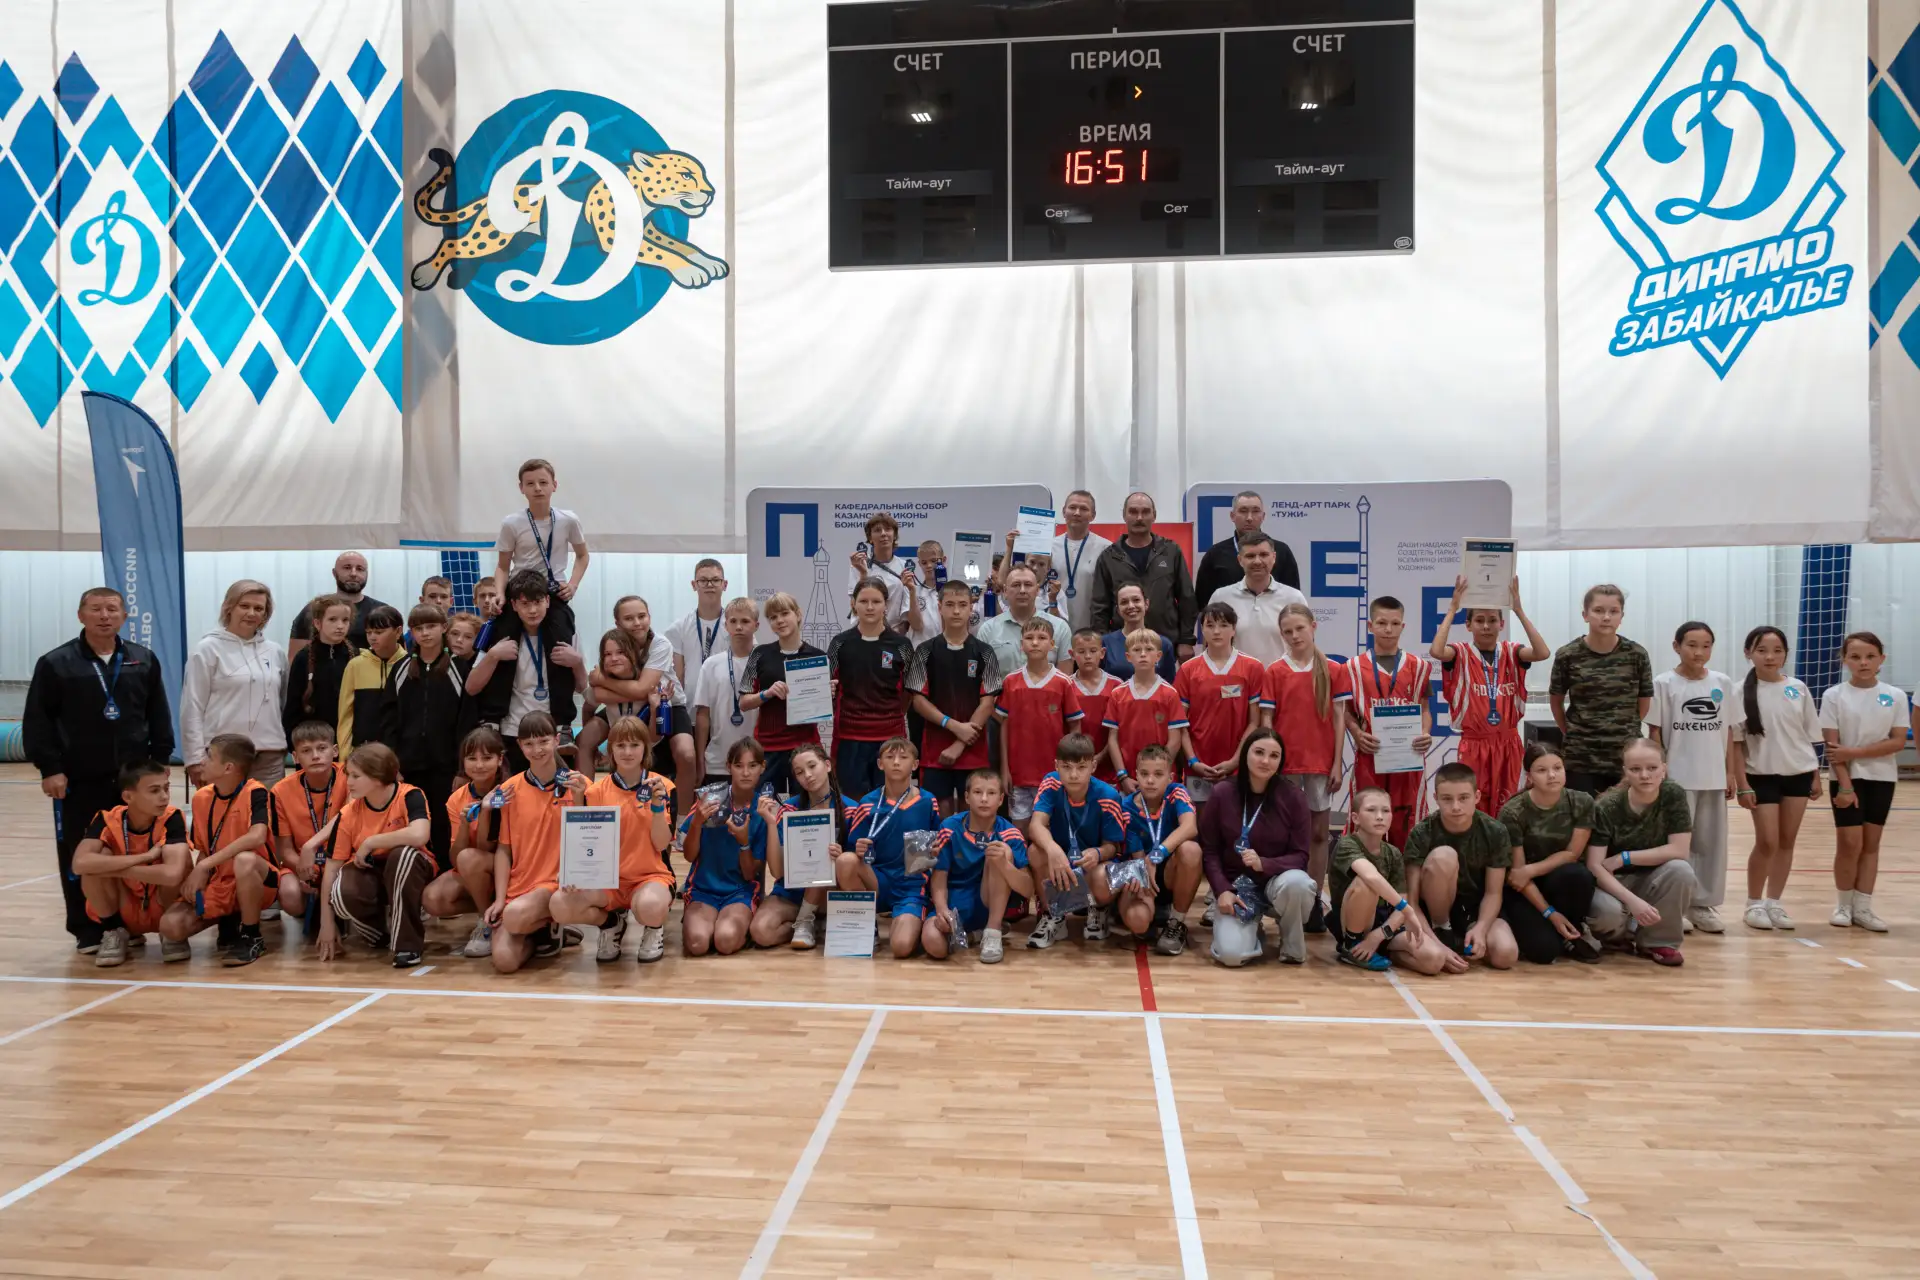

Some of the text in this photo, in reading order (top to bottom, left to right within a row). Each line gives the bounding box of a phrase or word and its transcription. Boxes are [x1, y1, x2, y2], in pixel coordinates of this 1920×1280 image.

[1292, 34, 1345, 54] СЧЕТ
[893, 52, 944, 73] СЧЕТ
[1070, 48, 1162, 71] ПЕРИОД
[1079, 123, 1152, 144] ВРЕМЯ
[1065, 150, 1147, 184] 16:51
[1274, 161, 1345, 176] Тайм-аут
[886, 176, 952, 191] Тайм-аут
[1044, 207, 1069, 219] Сет
[1163, 203, 1188, 214] Сет
[1634, 230, 1828, 307] ДИНАМО
[1616, 270, 1847, 350] ЗАБАЙКАЛЬЕ
[834, 502, 914, 511] КАФЕДРАЛЬНЫЙ
[1271, 501, 1351, 509] ЛЕНД-АРТ ПАРК
[893, 511, 928, 519] ИКОНЫ
[586, 848, 594, 857] 3
